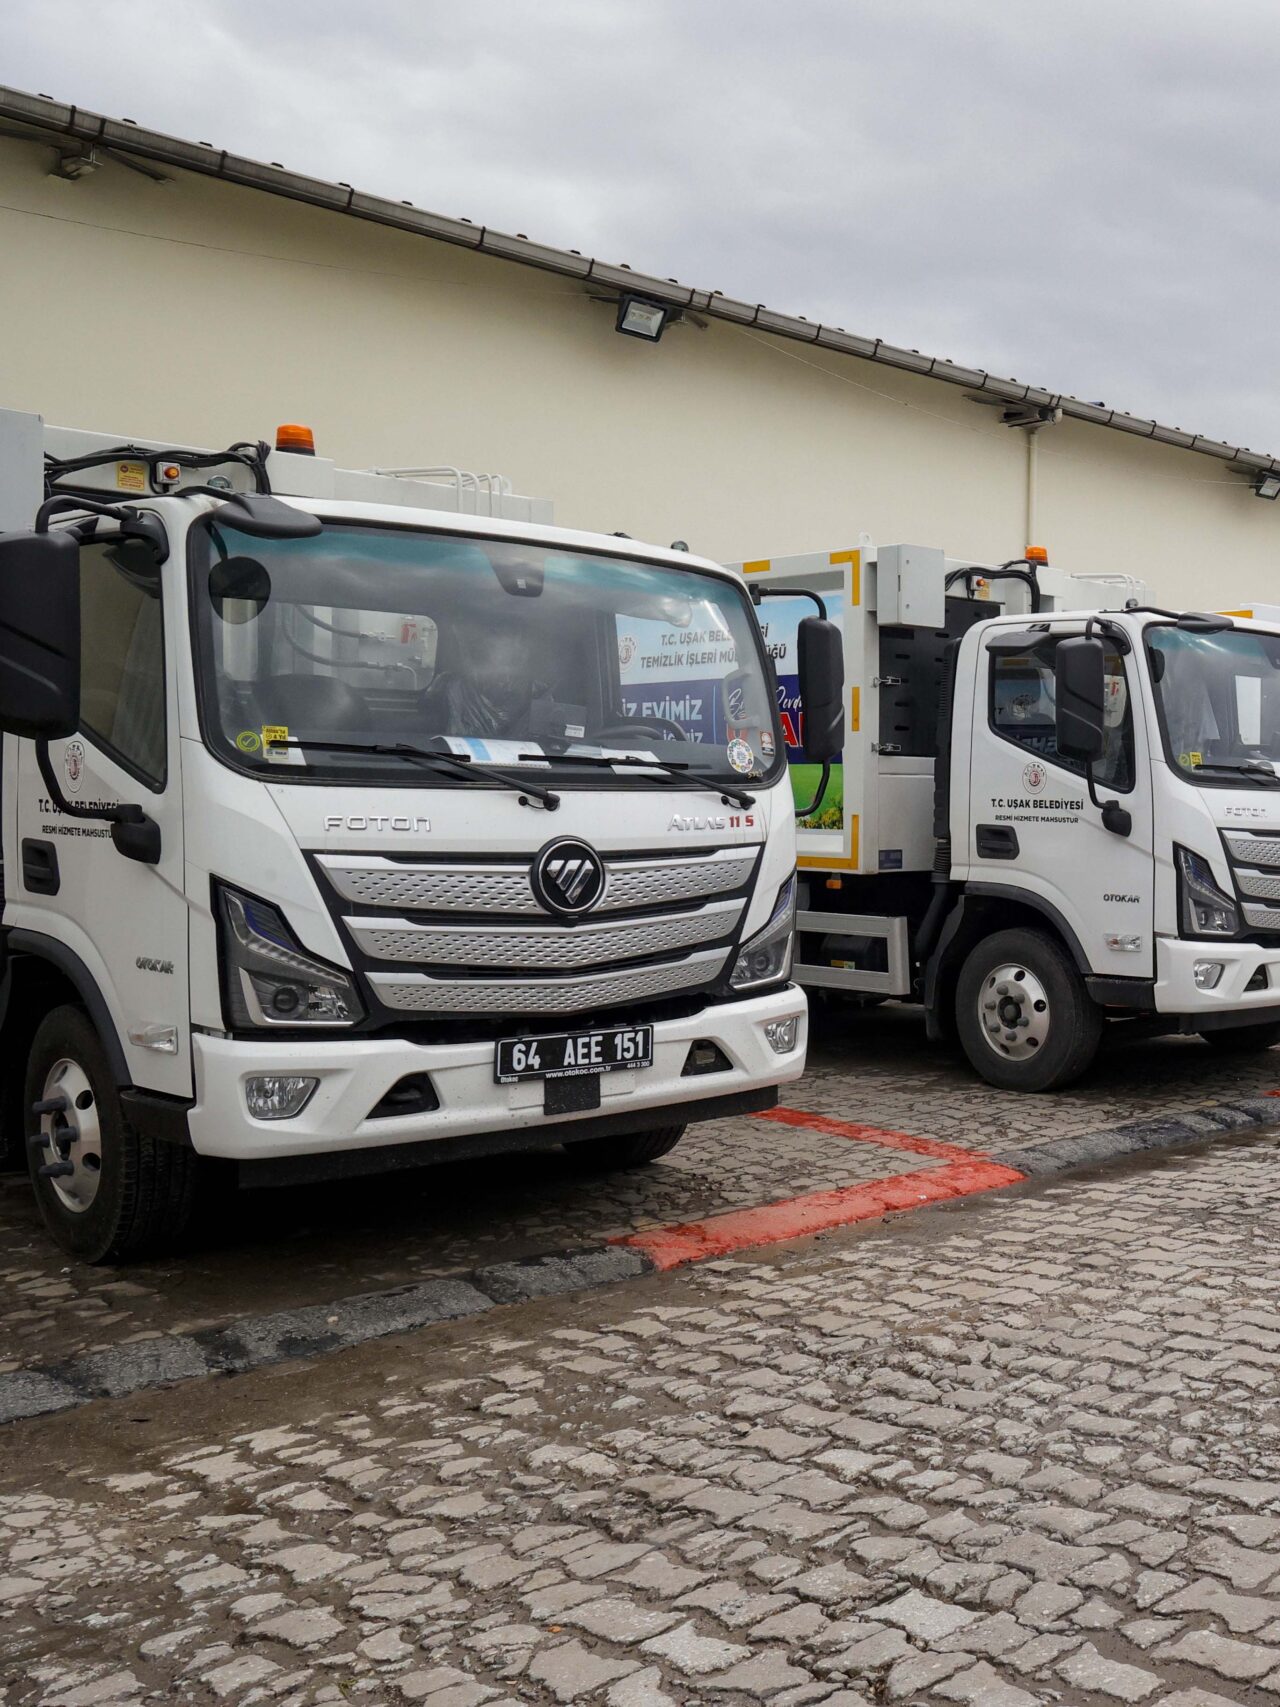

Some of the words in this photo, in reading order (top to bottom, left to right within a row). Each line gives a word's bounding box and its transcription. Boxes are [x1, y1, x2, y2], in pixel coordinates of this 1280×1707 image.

[661, 633, 677, 646] T.C.
[680, 631, 706, 646] UŞAK
[640, 651, 684, 669] TEMİZLİK
[686, 648, 717, 668] İŞLERİ
[642, 694, 703, 721] EVİMİZ
[39, 799, 52, 813] T.C.
[991, 799, 1006, 808] T.C.
[1007, 799, 1031, 810] UŞAK
[1033, 798, 1084, 810] BELEDİYESİ
[667, 813, 725, 832] ATLAS
[1041, 815, 1079, 824] MAHSUSTUR
[42, 824, 58, 835] RESMİ
[58, 825, 81, 837] HİZMETE
[81, 828, 112, 839] MAHSUSTU
[1103, 893, 1141, 904] OTOKAR
[512, 1042, 541, 1071] 64
[563, 1035, 604, 1066] AEE
[614, 1031, 644, 1060] 151
[545, 1065, 612, 1079] www.otokoc.com.tr
